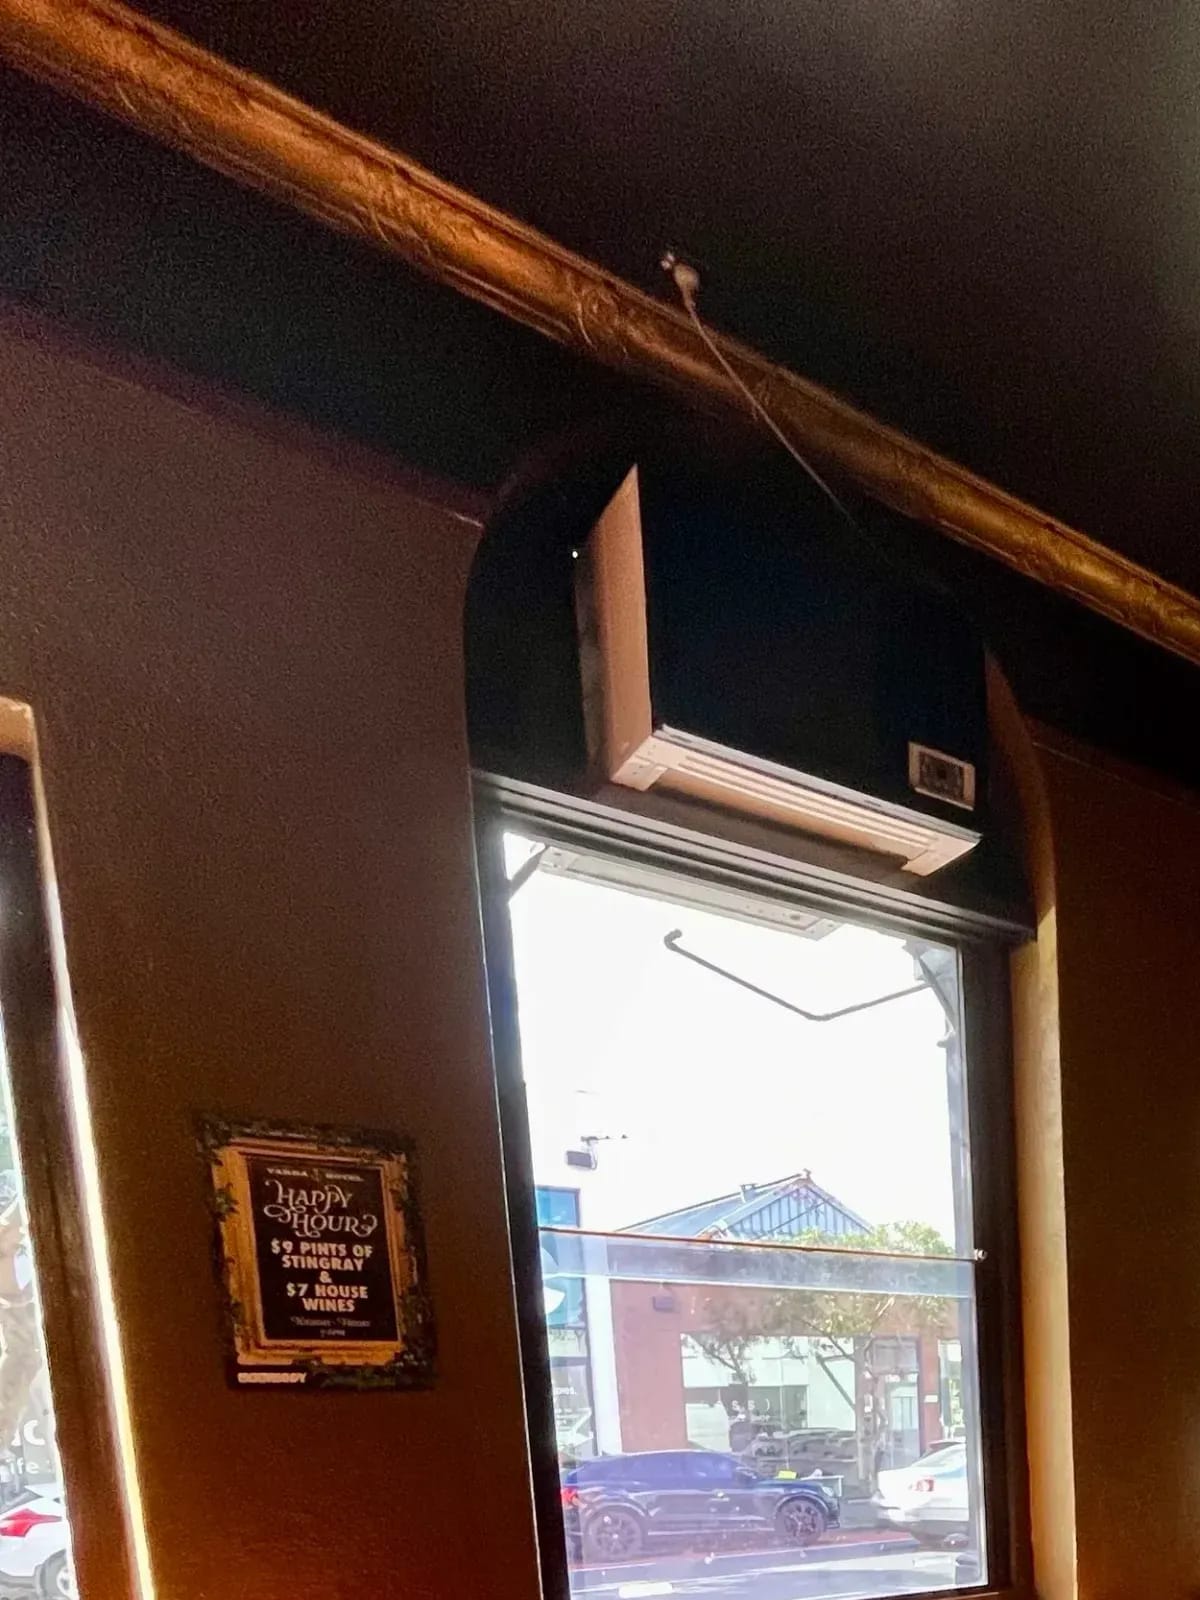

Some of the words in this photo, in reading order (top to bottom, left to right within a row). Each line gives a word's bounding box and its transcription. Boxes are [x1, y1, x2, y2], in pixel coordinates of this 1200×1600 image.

[264, 1179, 353, 1214] HAPPY
[263, 1204, 378, 1238] HOUR
[270, 1238, 294, 1255] $9
[300, 1241, 347, 1257] PINTS
[352, 1244, 374, 1259] OF
[281, 1255, 365, 1272] STINGRAY
[319, 1270, 333, 1284] &
[286, 1282, 309, 1298] $7
[314, 1283, 369, 1299] HOUSE
[302, 1297, 356, 1313] WINES
